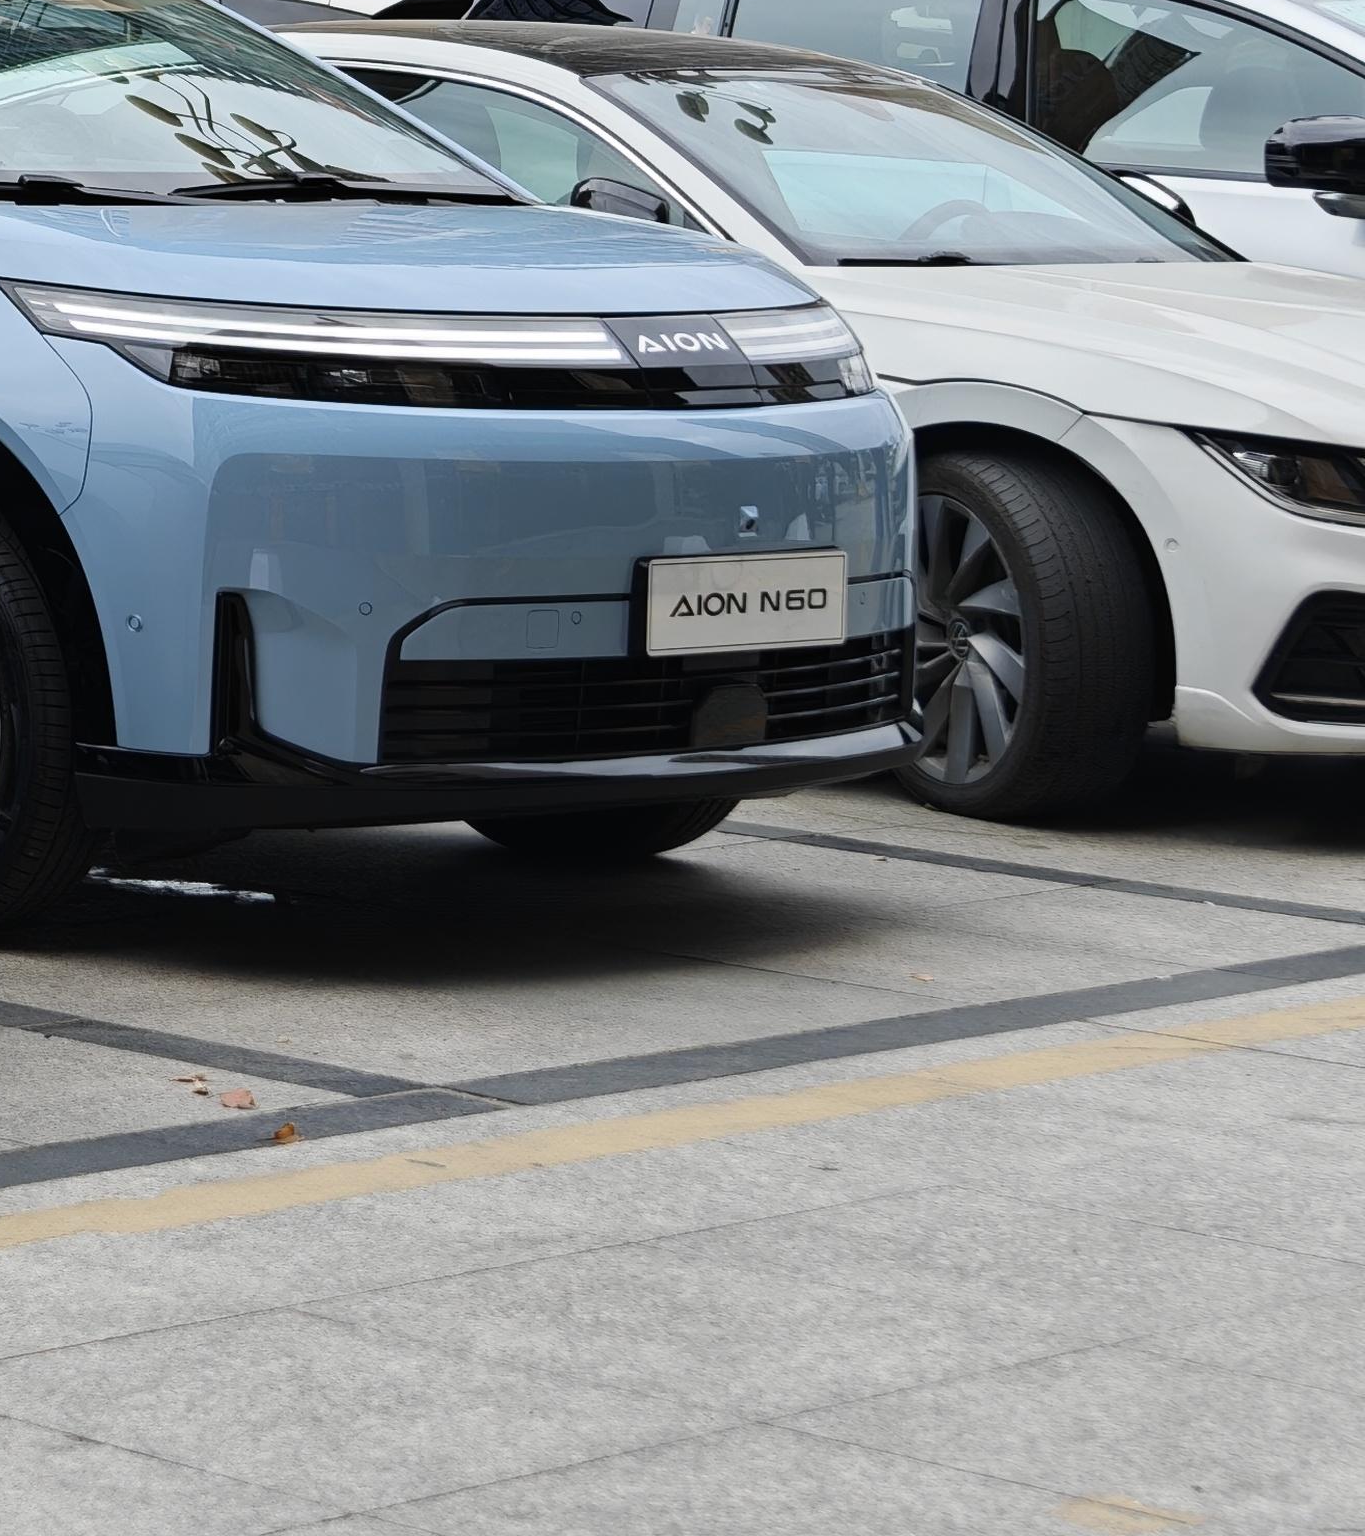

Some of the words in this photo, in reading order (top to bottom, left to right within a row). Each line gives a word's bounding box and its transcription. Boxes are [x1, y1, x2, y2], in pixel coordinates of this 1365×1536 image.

[638, 332, 730, 354] AION
[669, 592, 747, 618] AION
[760, 588, 827, 613] N60
